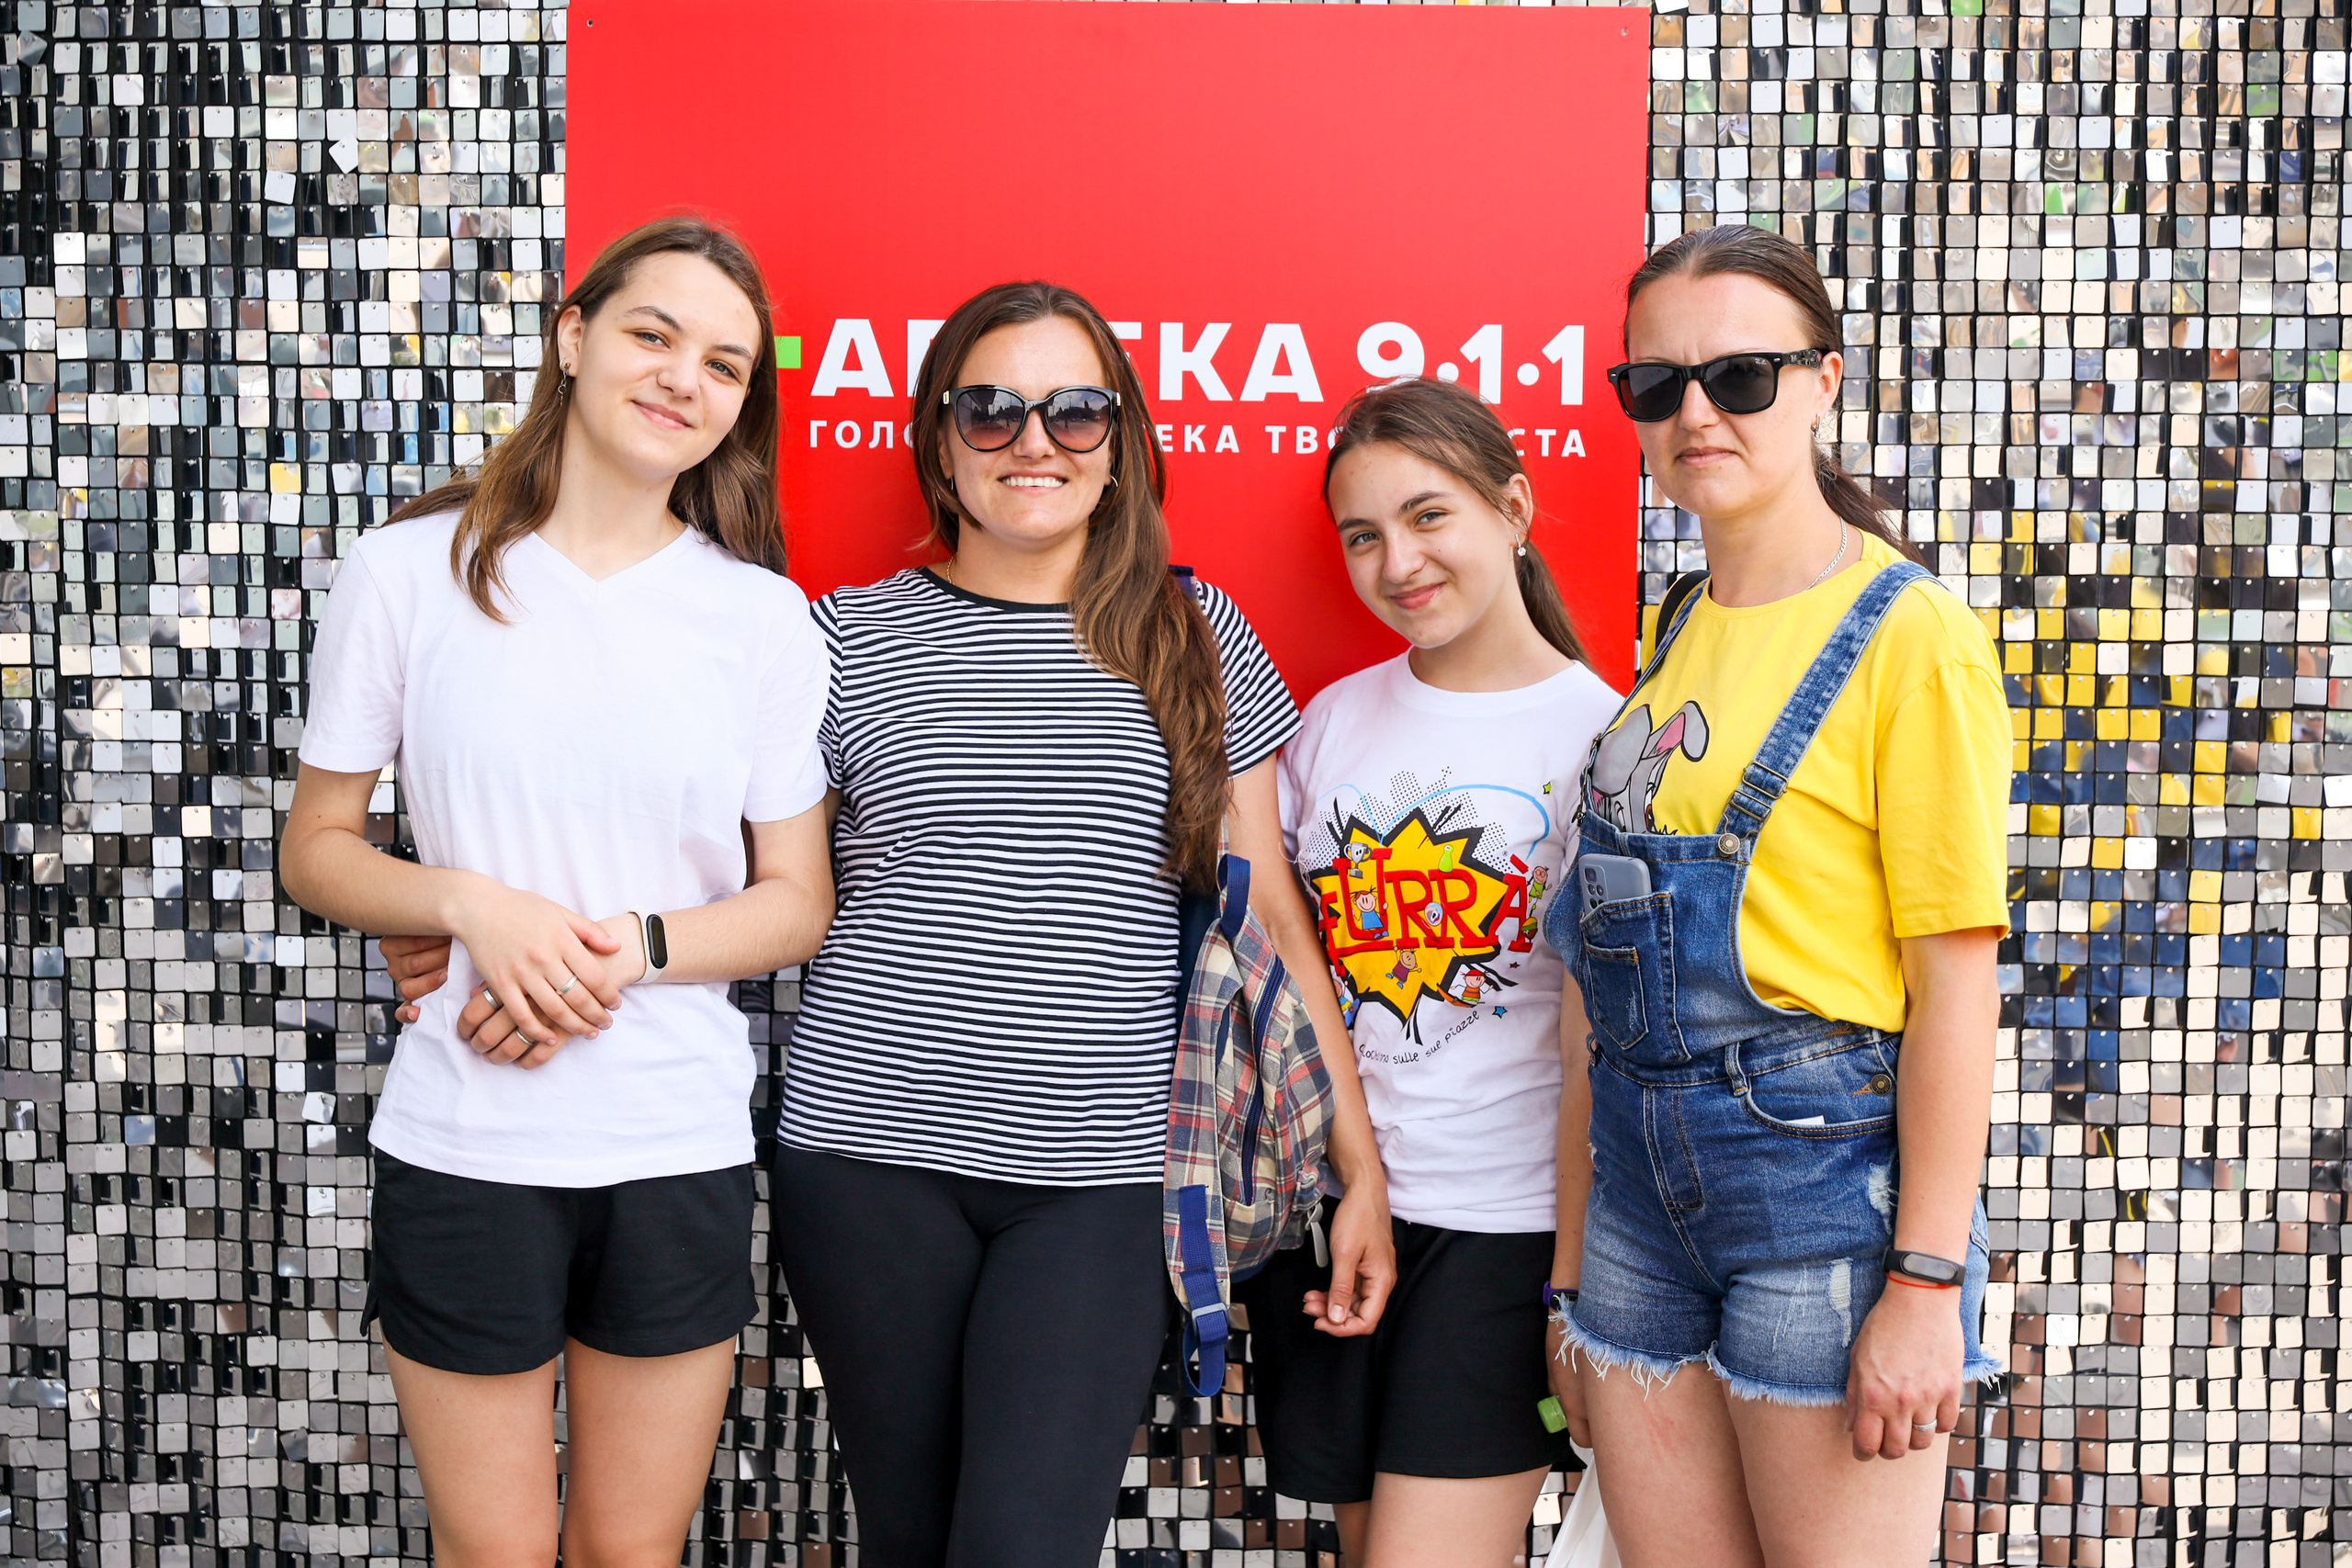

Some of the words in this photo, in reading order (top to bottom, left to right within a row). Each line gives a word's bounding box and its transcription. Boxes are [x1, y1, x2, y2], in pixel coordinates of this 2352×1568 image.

[1392, 1052, 1419, 1065] sulle
[1425, 1040, 1442, 1057] sue
[1444, 1010, 1480, 1043] piazze
